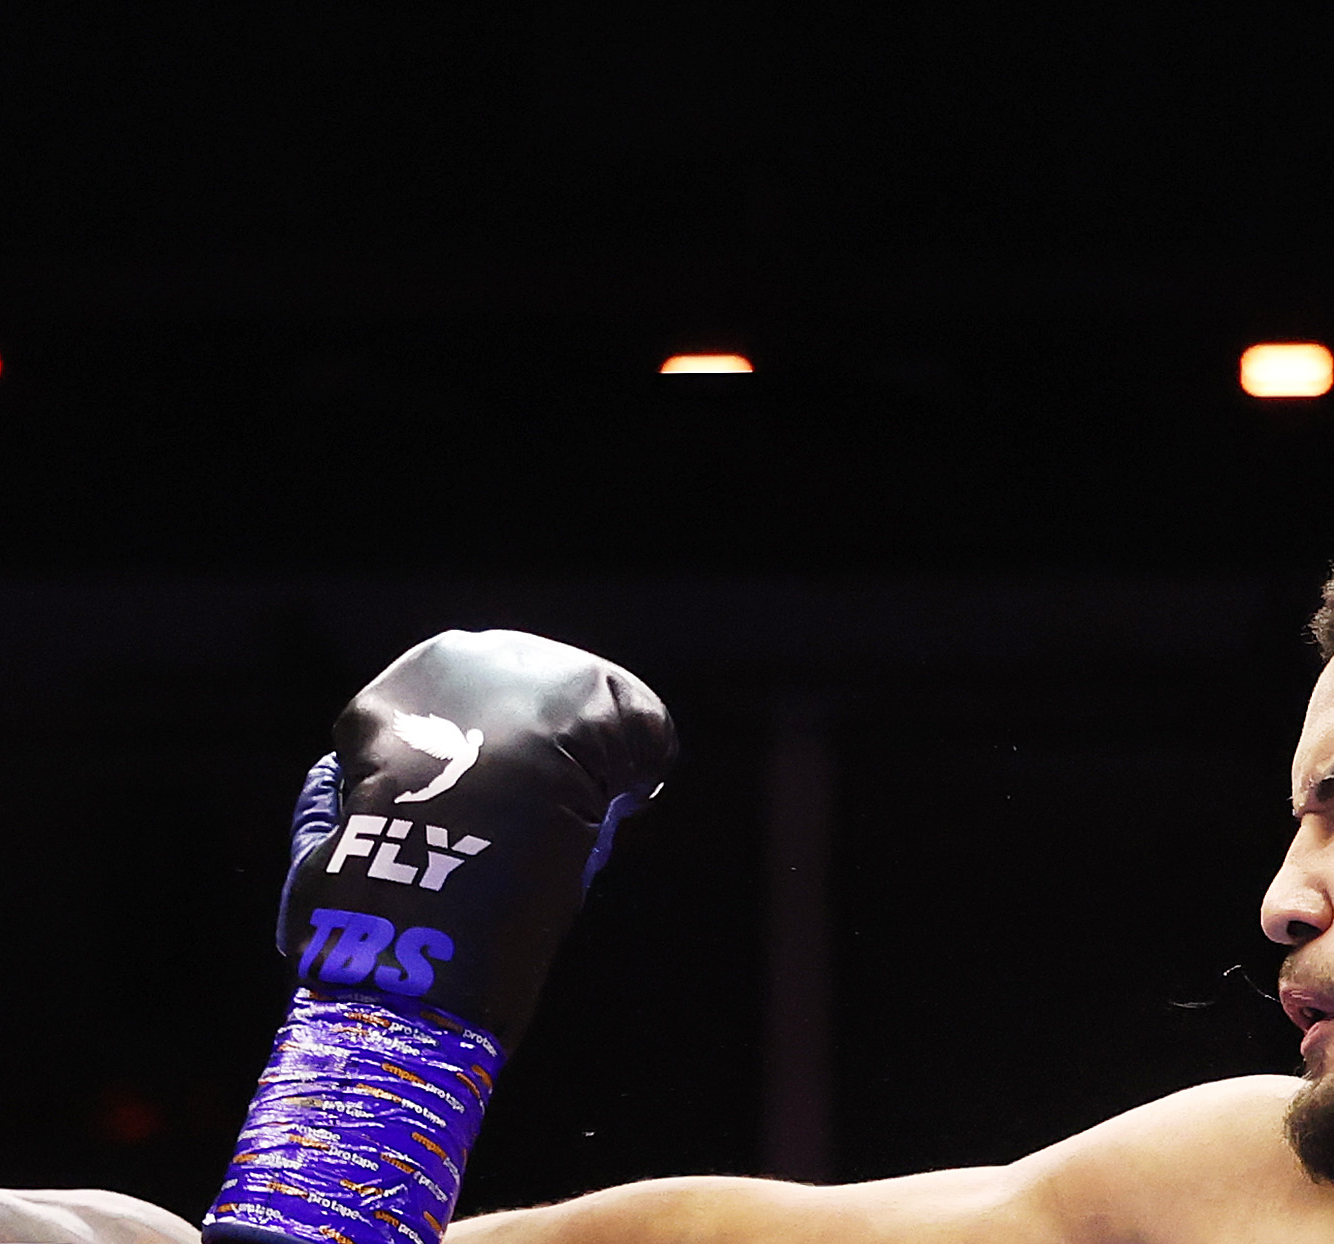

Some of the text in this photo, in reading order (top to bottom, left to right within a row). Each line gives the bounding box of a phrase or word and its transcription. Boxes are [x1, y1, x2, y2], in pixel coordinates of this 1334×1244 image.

[326, 814, 491, 891] FLY
[298, 909, 455, 997] TBS
[329, 1200, 359, 1220] tape
